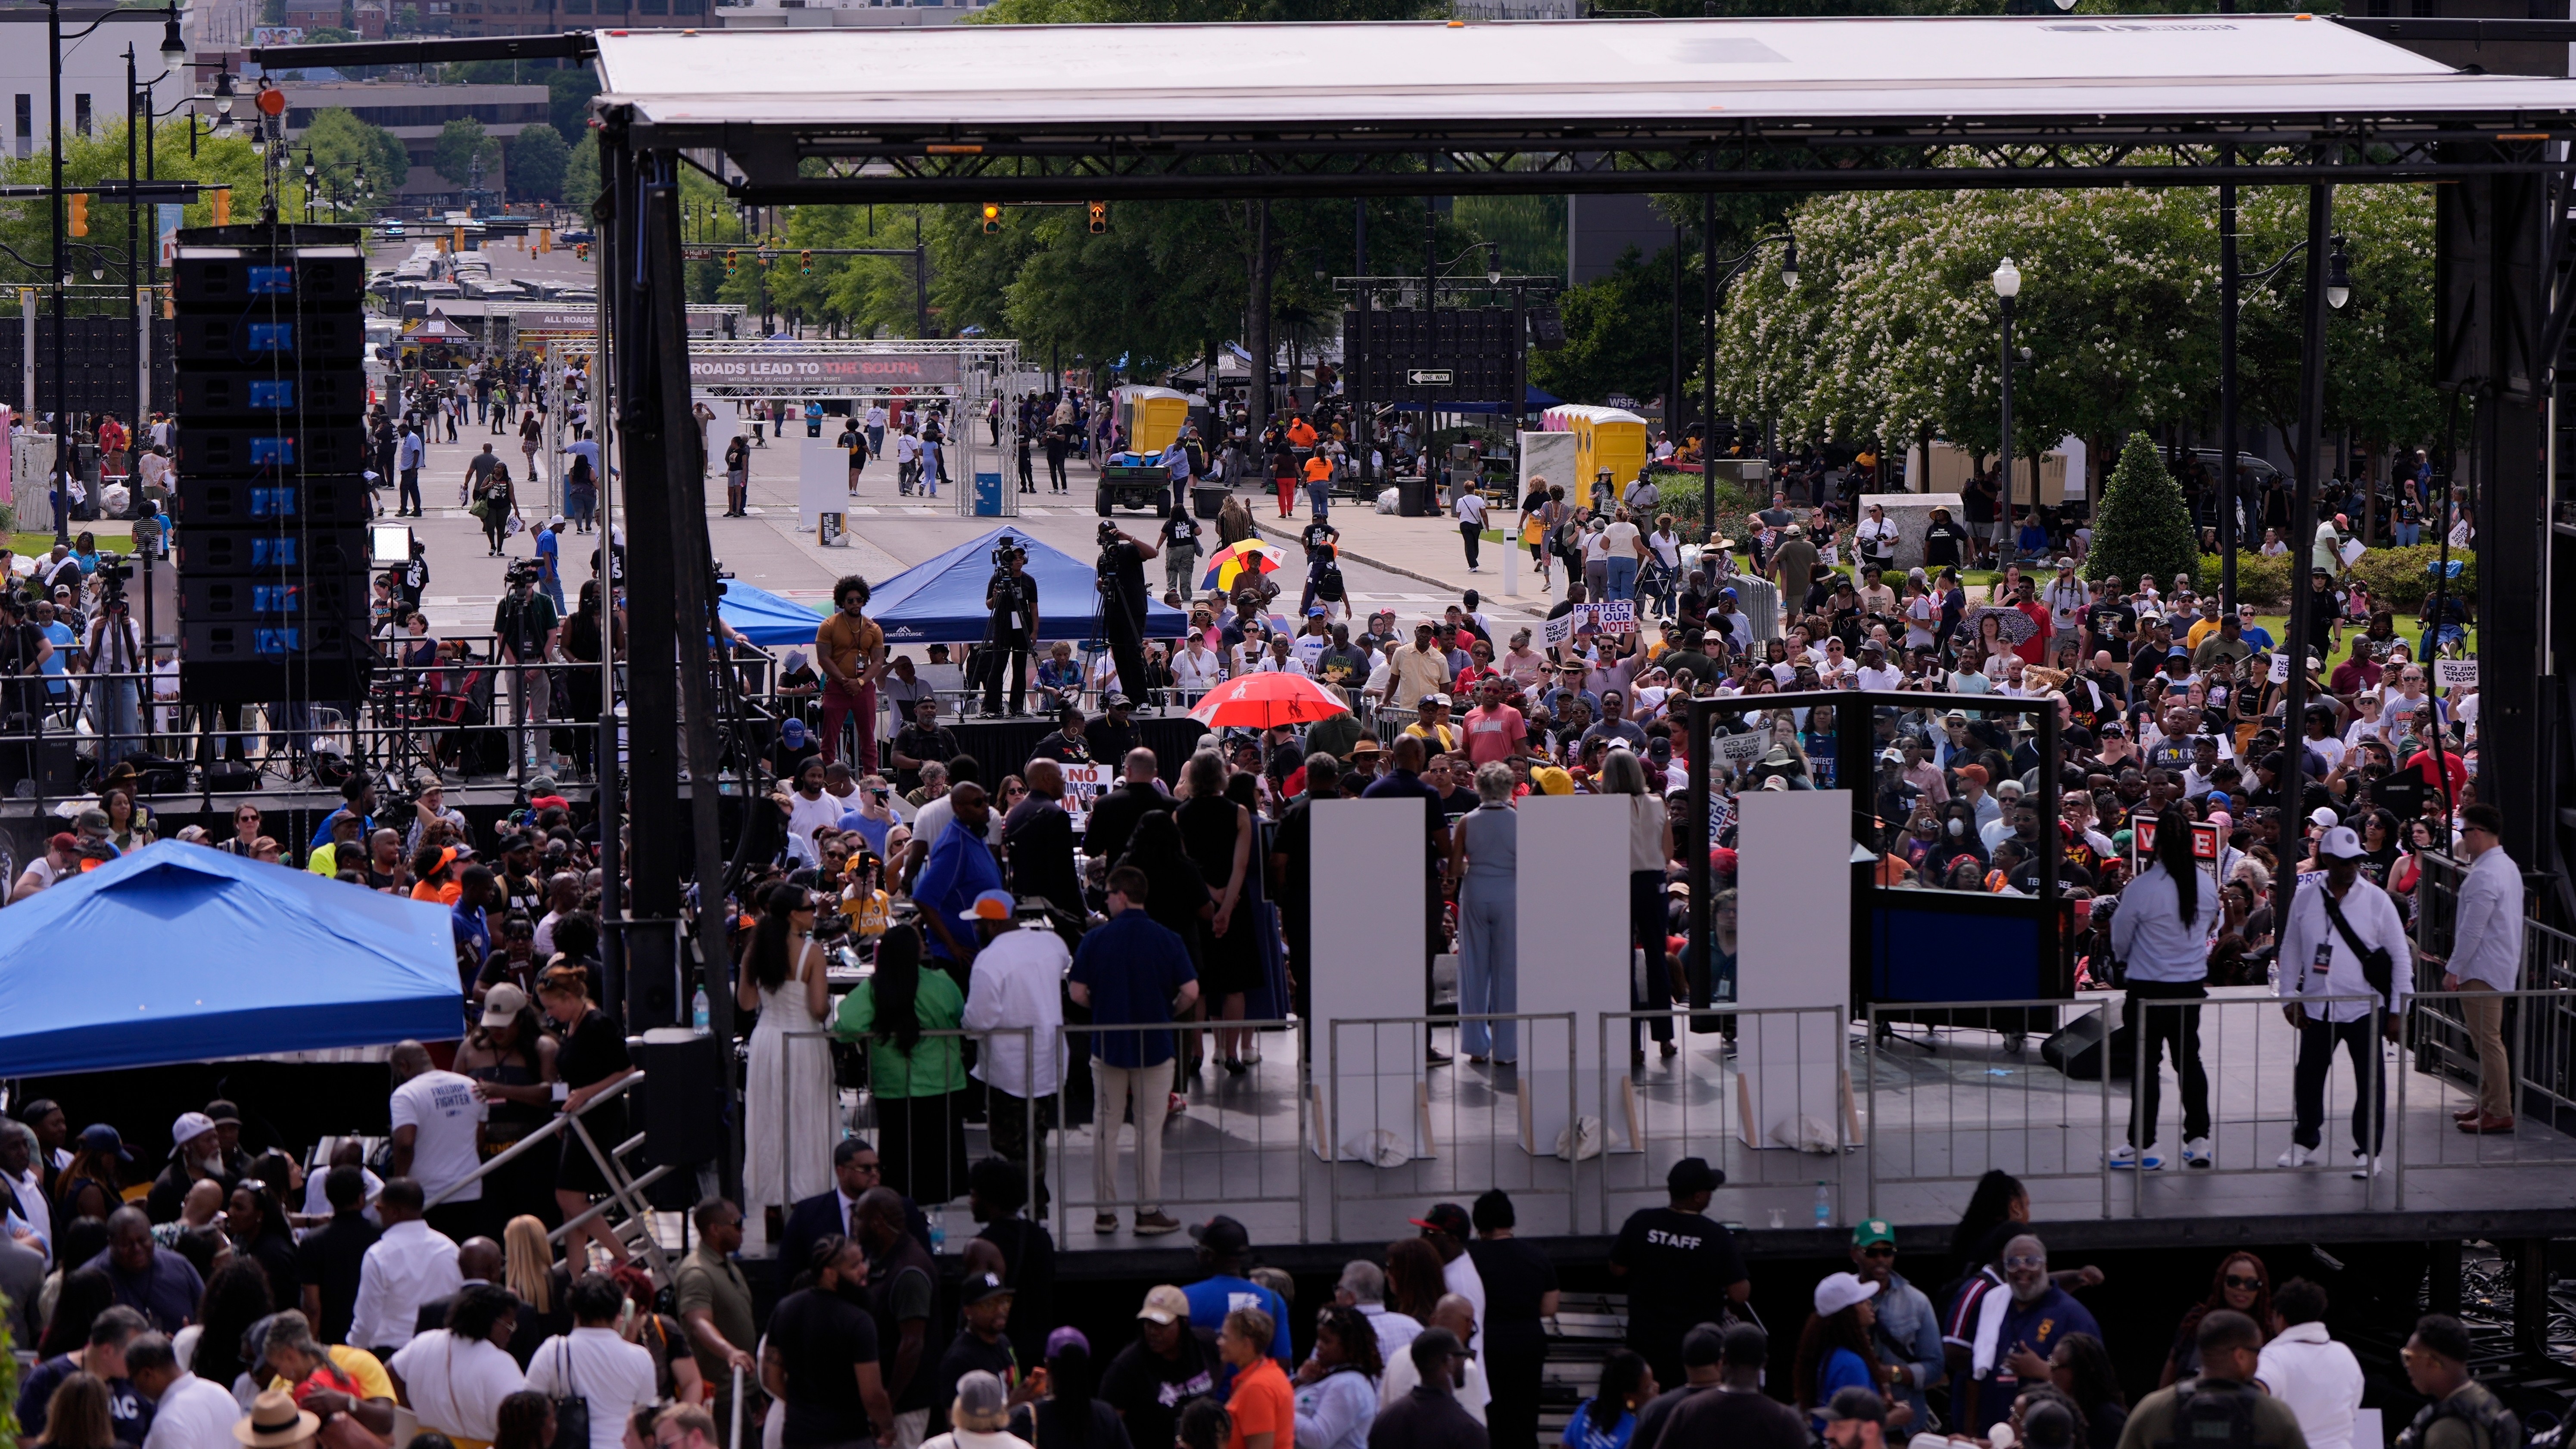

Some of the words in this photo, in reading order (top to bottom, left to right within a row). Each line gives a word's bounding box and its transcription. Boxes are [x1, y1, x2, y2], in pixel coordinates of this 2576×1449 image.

[690, 363, 746, 375] ROADS
[750, 363, 793, 375] LEAD
[797, 363, 819, 374] TO
[825, 362, 857, 374] THE
[861, 362, 919, 374] SOUTH
[1609, 398, 1641, 407] WSFA
[1642, 398, 1661, 409] 12
[2451, 526, 2465, 540] MAPS
[407, 571, 421, 588] US
[1576, 603, 1632, 613] PROTECT
[1604, 613, 1630, 621] OUR
[1560, 619, 1569, 629] JIM
[1601, 621, 1633, 633] VOTE!
[1546, 625, 1568, 637] CROW
[1548, 631, 1567, 643] MAPS
[1327, 657, 1354, 668] JAMAICA
[1473, 721, 1501, 732] ALABAMA
[1743, 737, 1760, 746] JIM
[1724, 743, 1760, 754] CROW
[1726, 749, 1759, 759] MAPS
[1068, 768, 1098, 783] NO
[1709, 805, 1727, 836] OUR
[2138, 827, 2211, 855] VE
[860, 917, 885, 927] LOVE
[1647, 1228, 1702, 1250] STAFF
